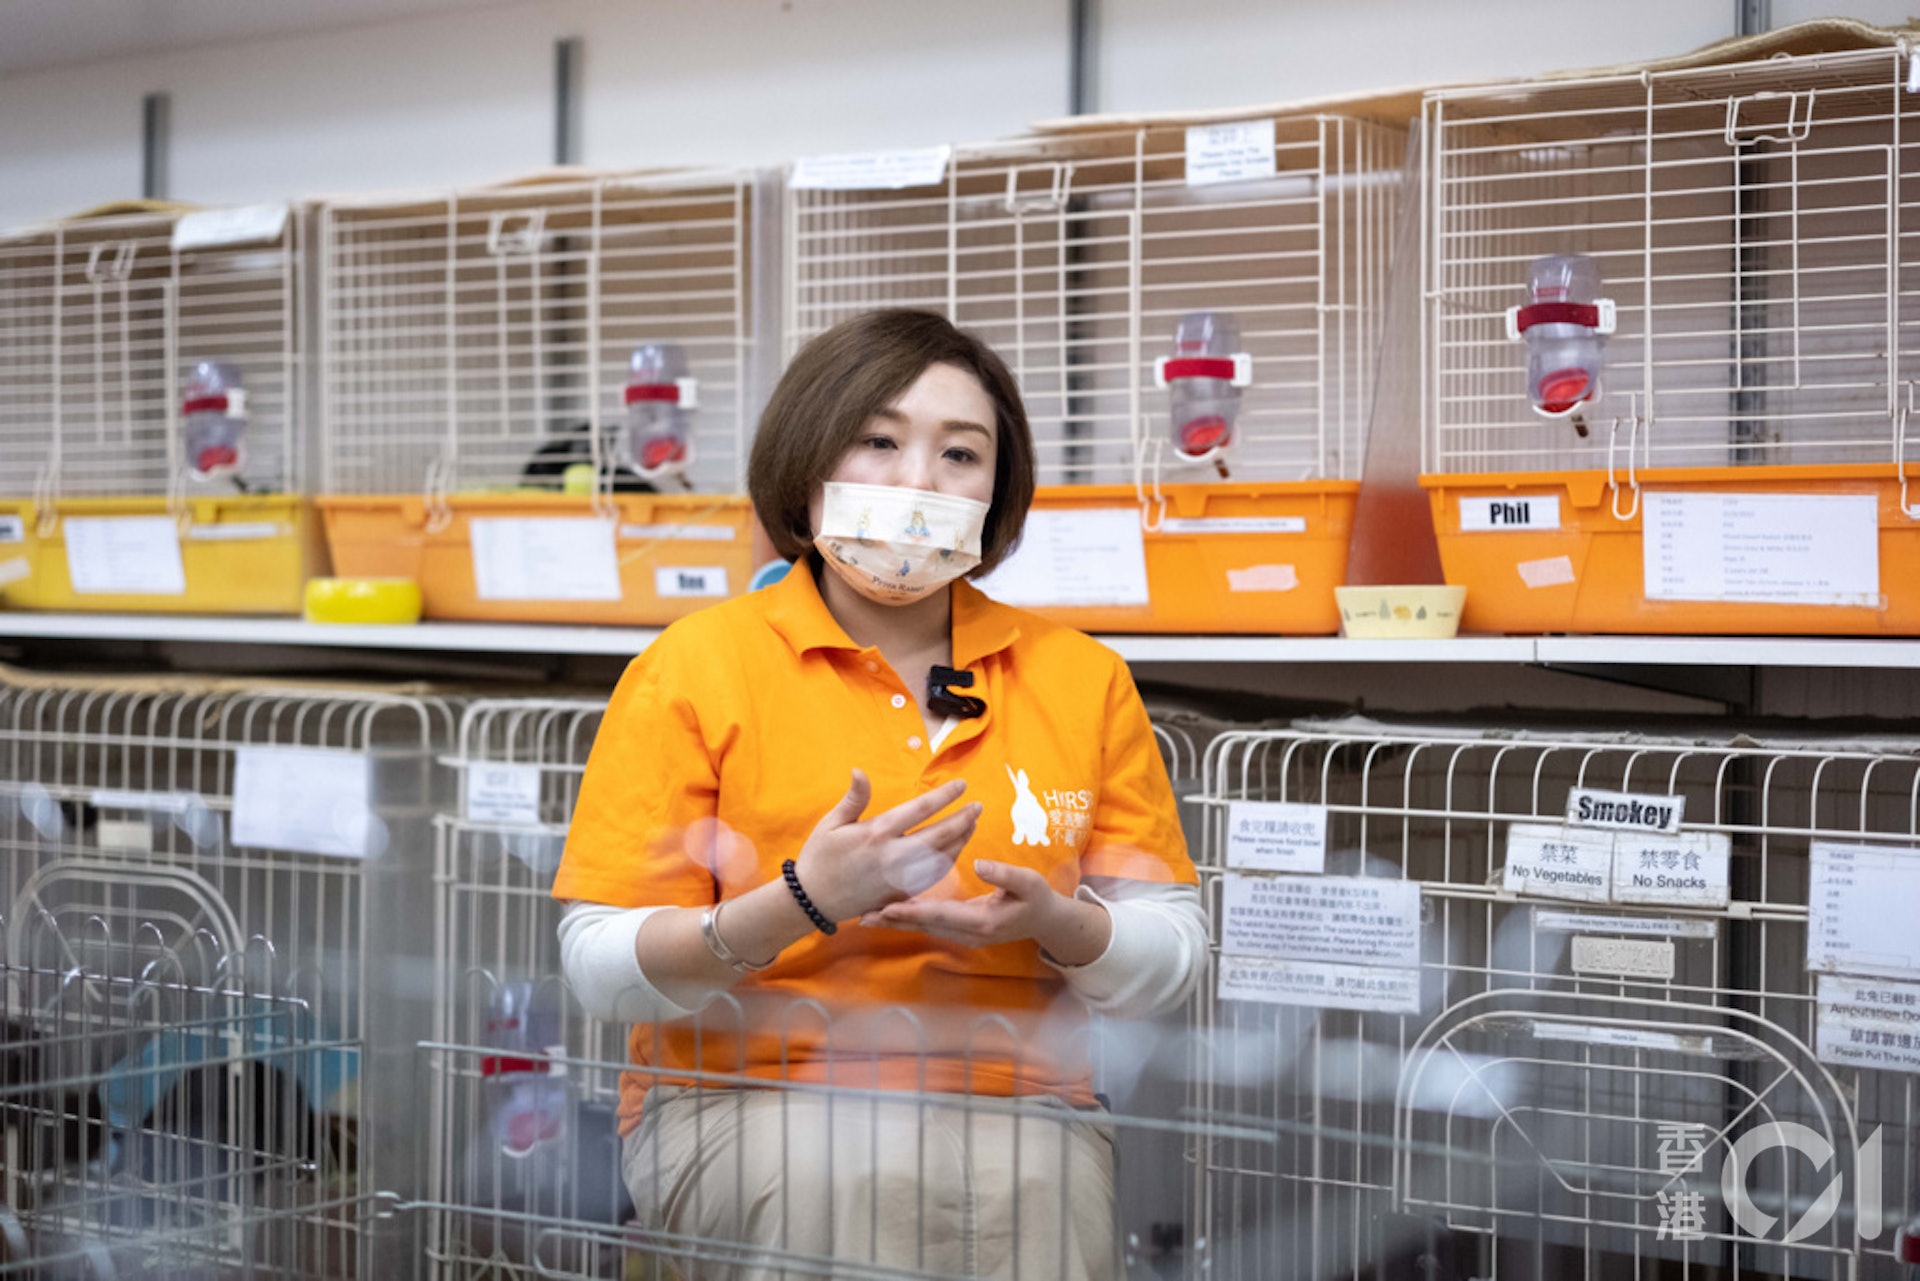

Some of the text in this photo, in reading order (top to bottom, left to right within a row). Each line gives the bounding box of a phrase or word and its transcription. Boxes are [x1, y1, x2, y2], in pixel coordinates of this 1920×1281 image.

[1490, 502, 1530, 525] Phil
[1578, 795, 1673, 829] Smokey
[1232, 834, 1321, 847] Please remove food bowl
[1256, 847, 1274, 855] when
[1539, 842, 1579, 865] 禁菜
[1639, 848, 1703, 872] 禁零食
[1512, 864, 1603, 887] No Vegetables
[1632, 874, 1707, 890] No Snacks
[1830, 1003, 1900, 1019] Amputation
[1835, 1045, 1863, 1059] Please
[1865, 1049, 1881, 1061] Put
[1883, 1051, 1900, 1062] The
